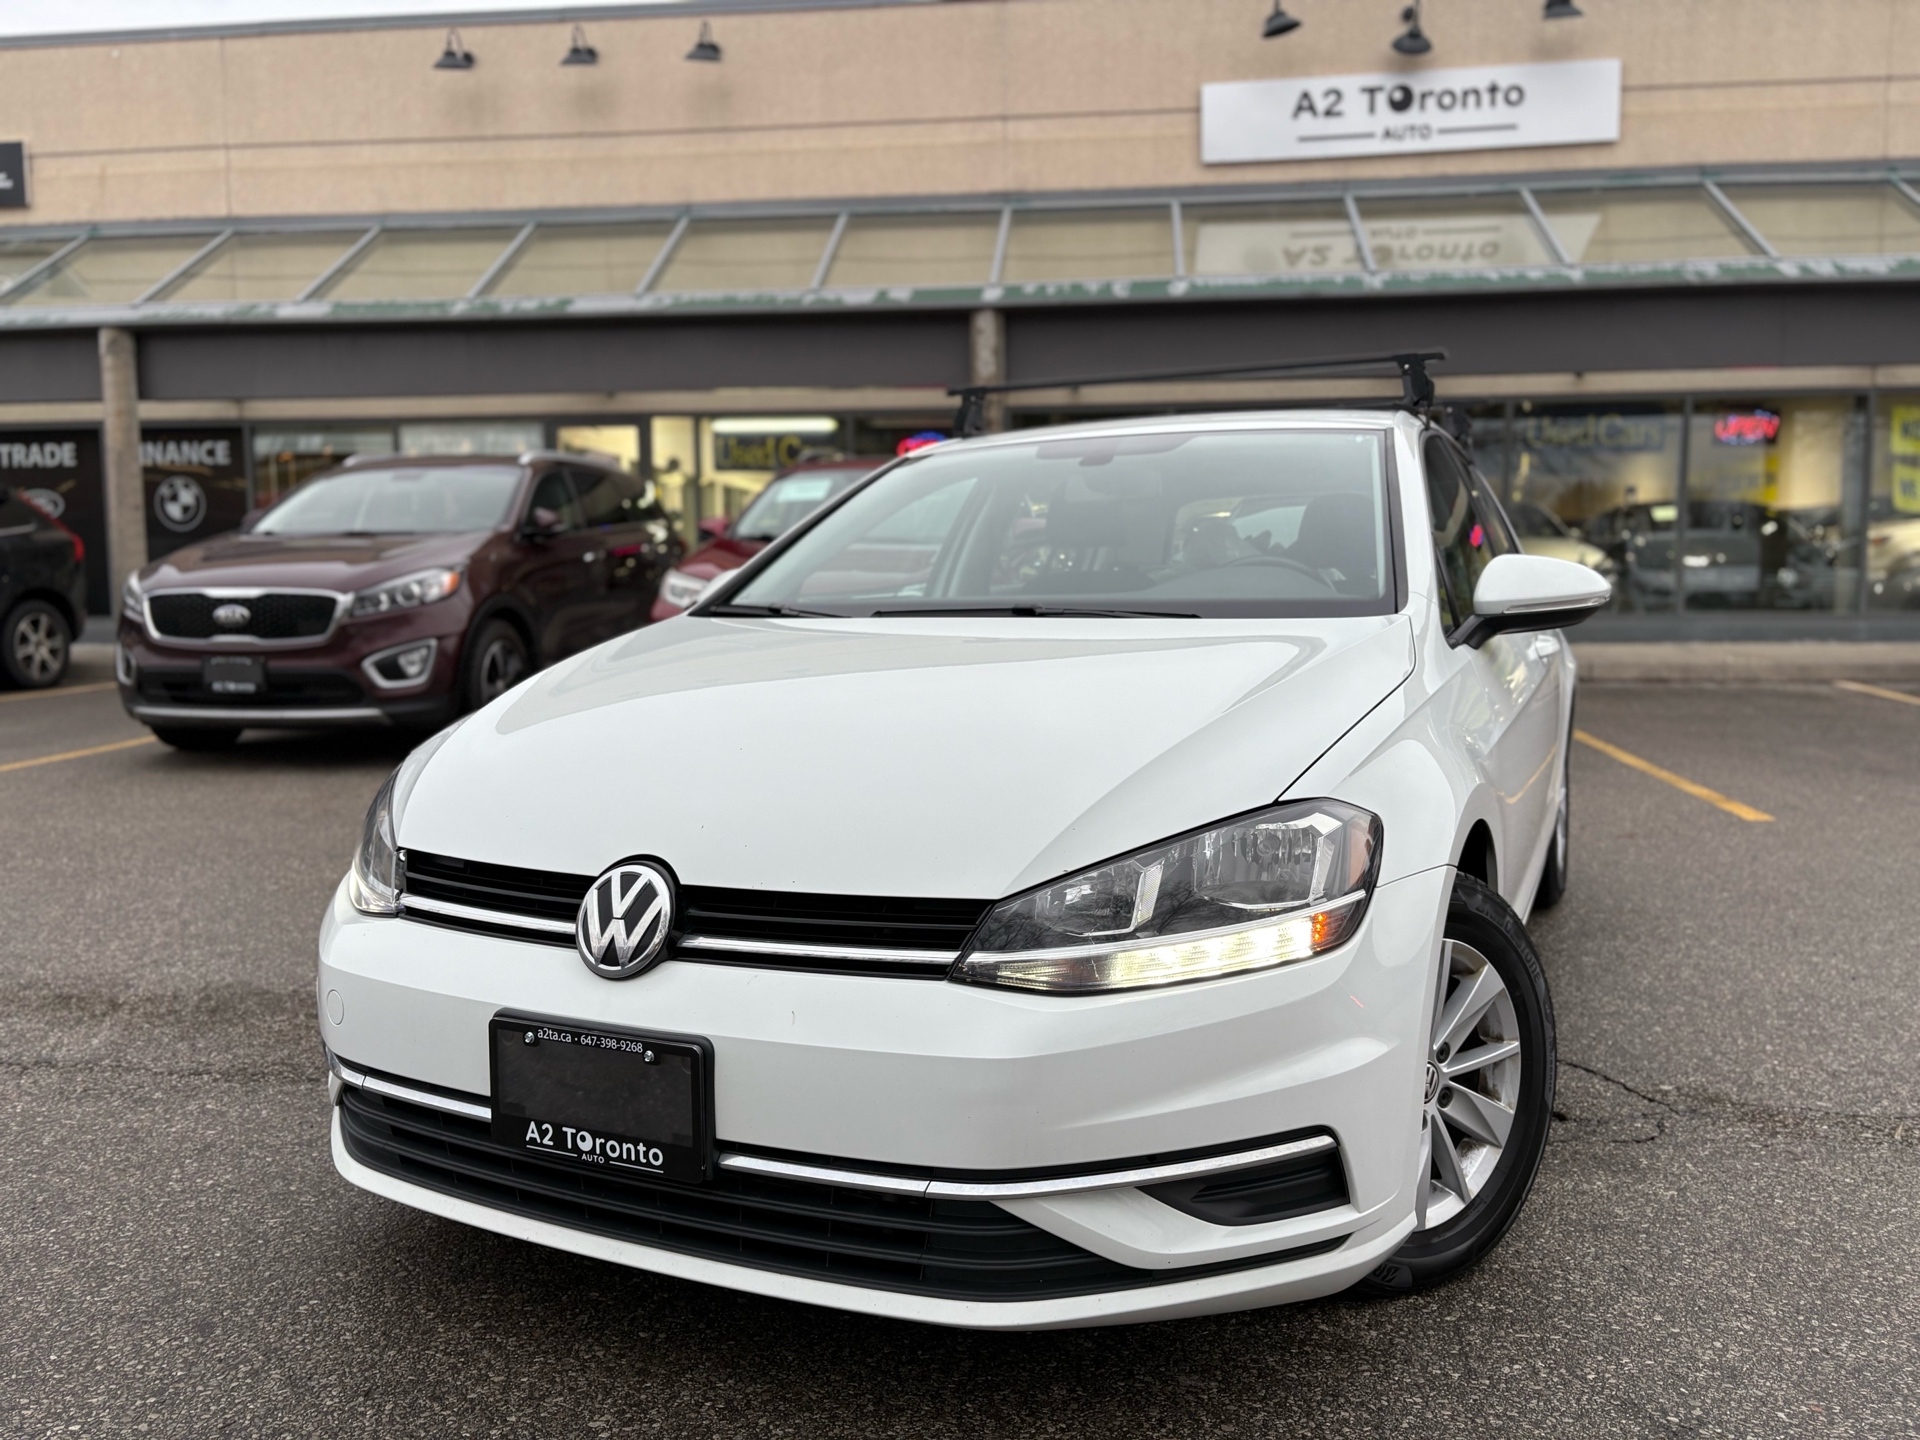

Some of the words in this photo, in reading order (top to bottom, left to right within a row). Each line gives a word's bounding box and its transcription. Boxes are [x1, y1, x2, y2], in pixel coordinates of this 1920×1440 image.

[1293, 88, 1343, 119] A2
[1381, 123, 1433, 142] AUTO
[0, 442, 77, 468] TRADE
[137, 440, 232, 466] INANCE
[537, 1027, 572, 1043] a2ta.ca
[580, 1034, 643, 1054] 647-398-9268
[525, 1120, 554, 1146] A2
[581, 1152, 605, 1164] AUTO
